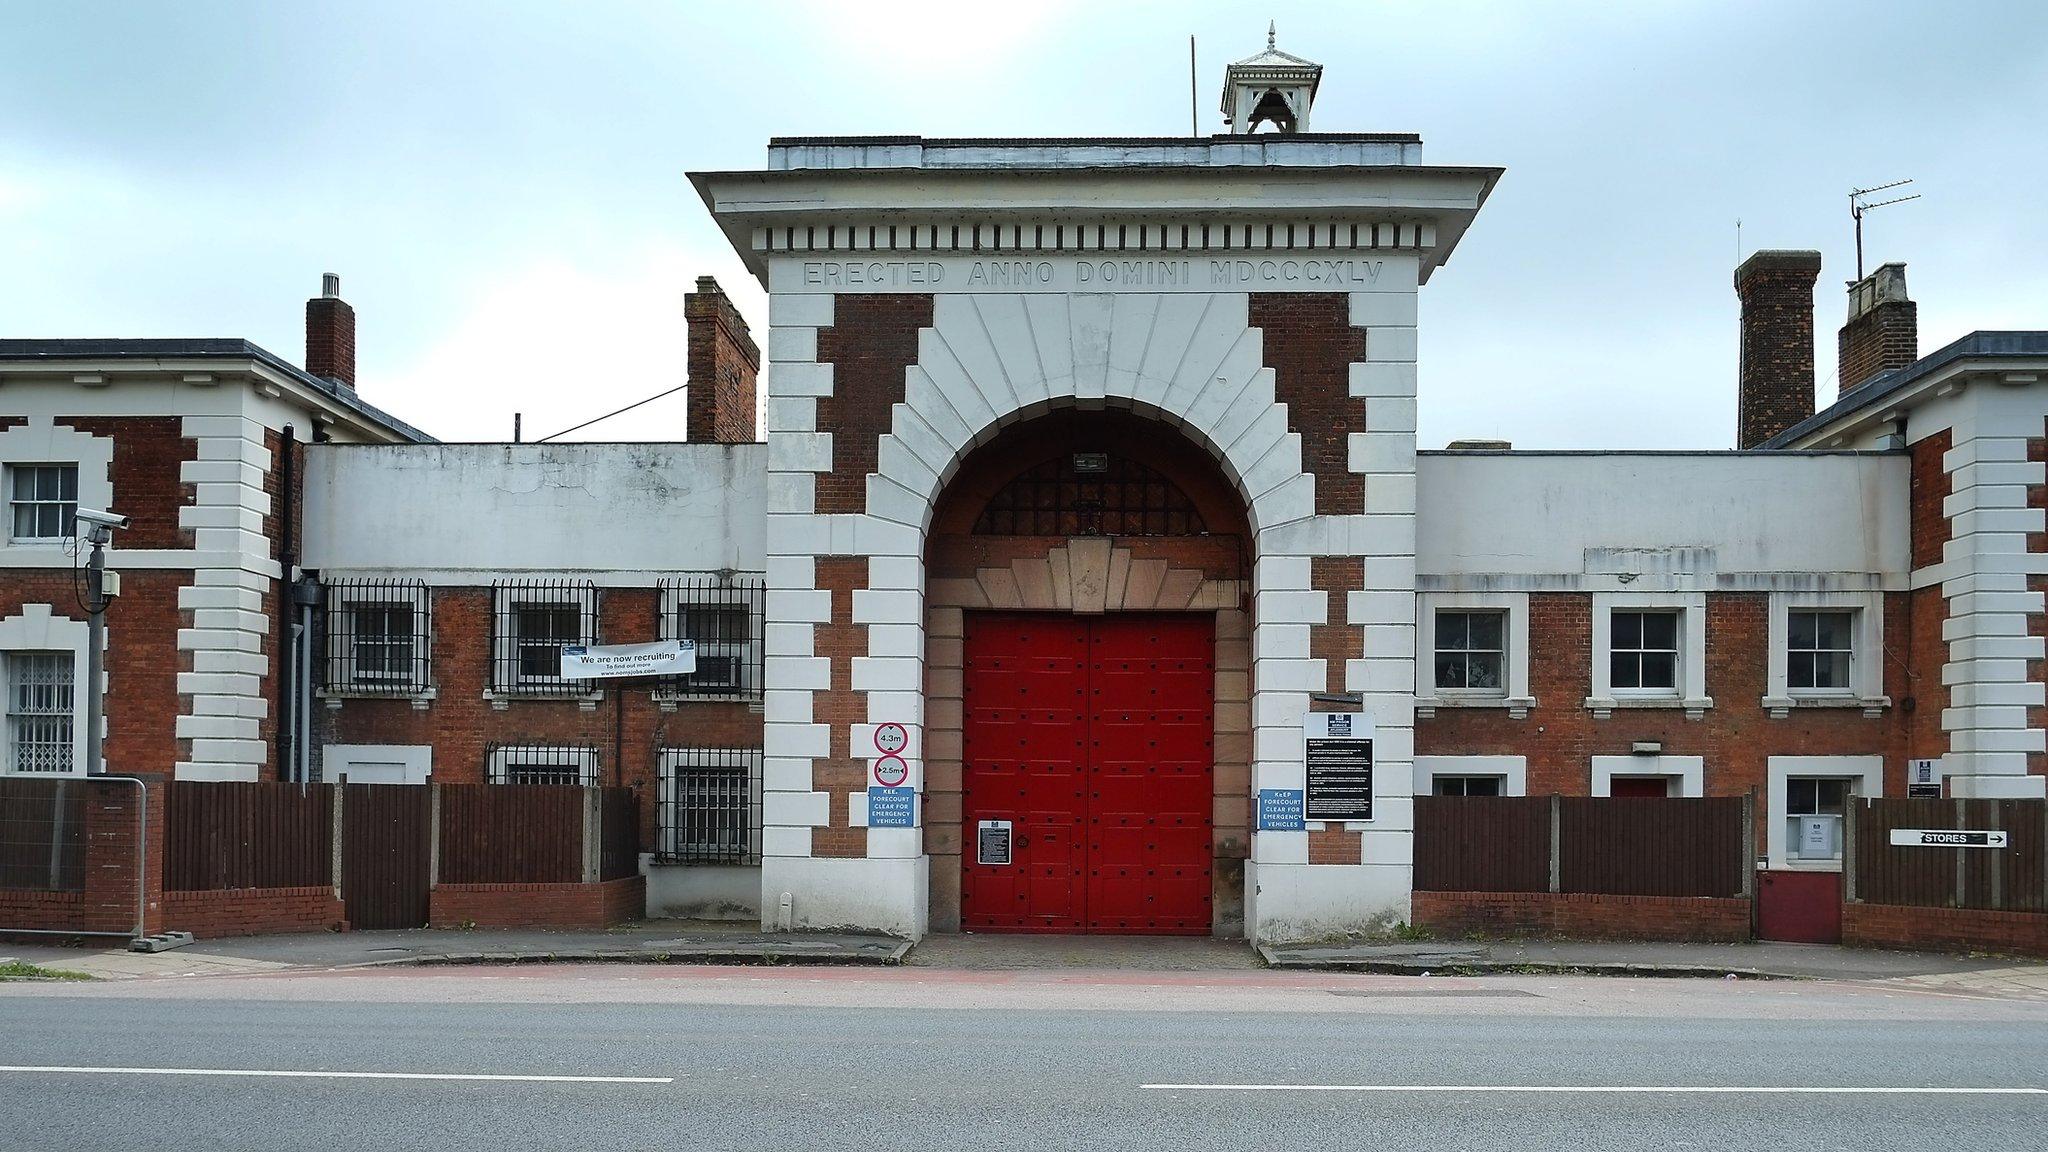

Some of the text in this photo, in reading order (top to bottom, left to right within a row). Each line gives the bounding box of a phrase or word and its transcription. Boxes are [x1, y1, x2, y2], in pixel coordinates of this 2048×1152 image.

[803, 260, 1384, 286] ERECTED ANNO DOMINI MDCCCXLV
[580, 656, 595, 664] We
[613, 655, 632, 663] now
[634, 652, 676, 661] recruiting
[880, 734, 901, 742] 4.3m
[1925, 833, 1967, 843] STORES
